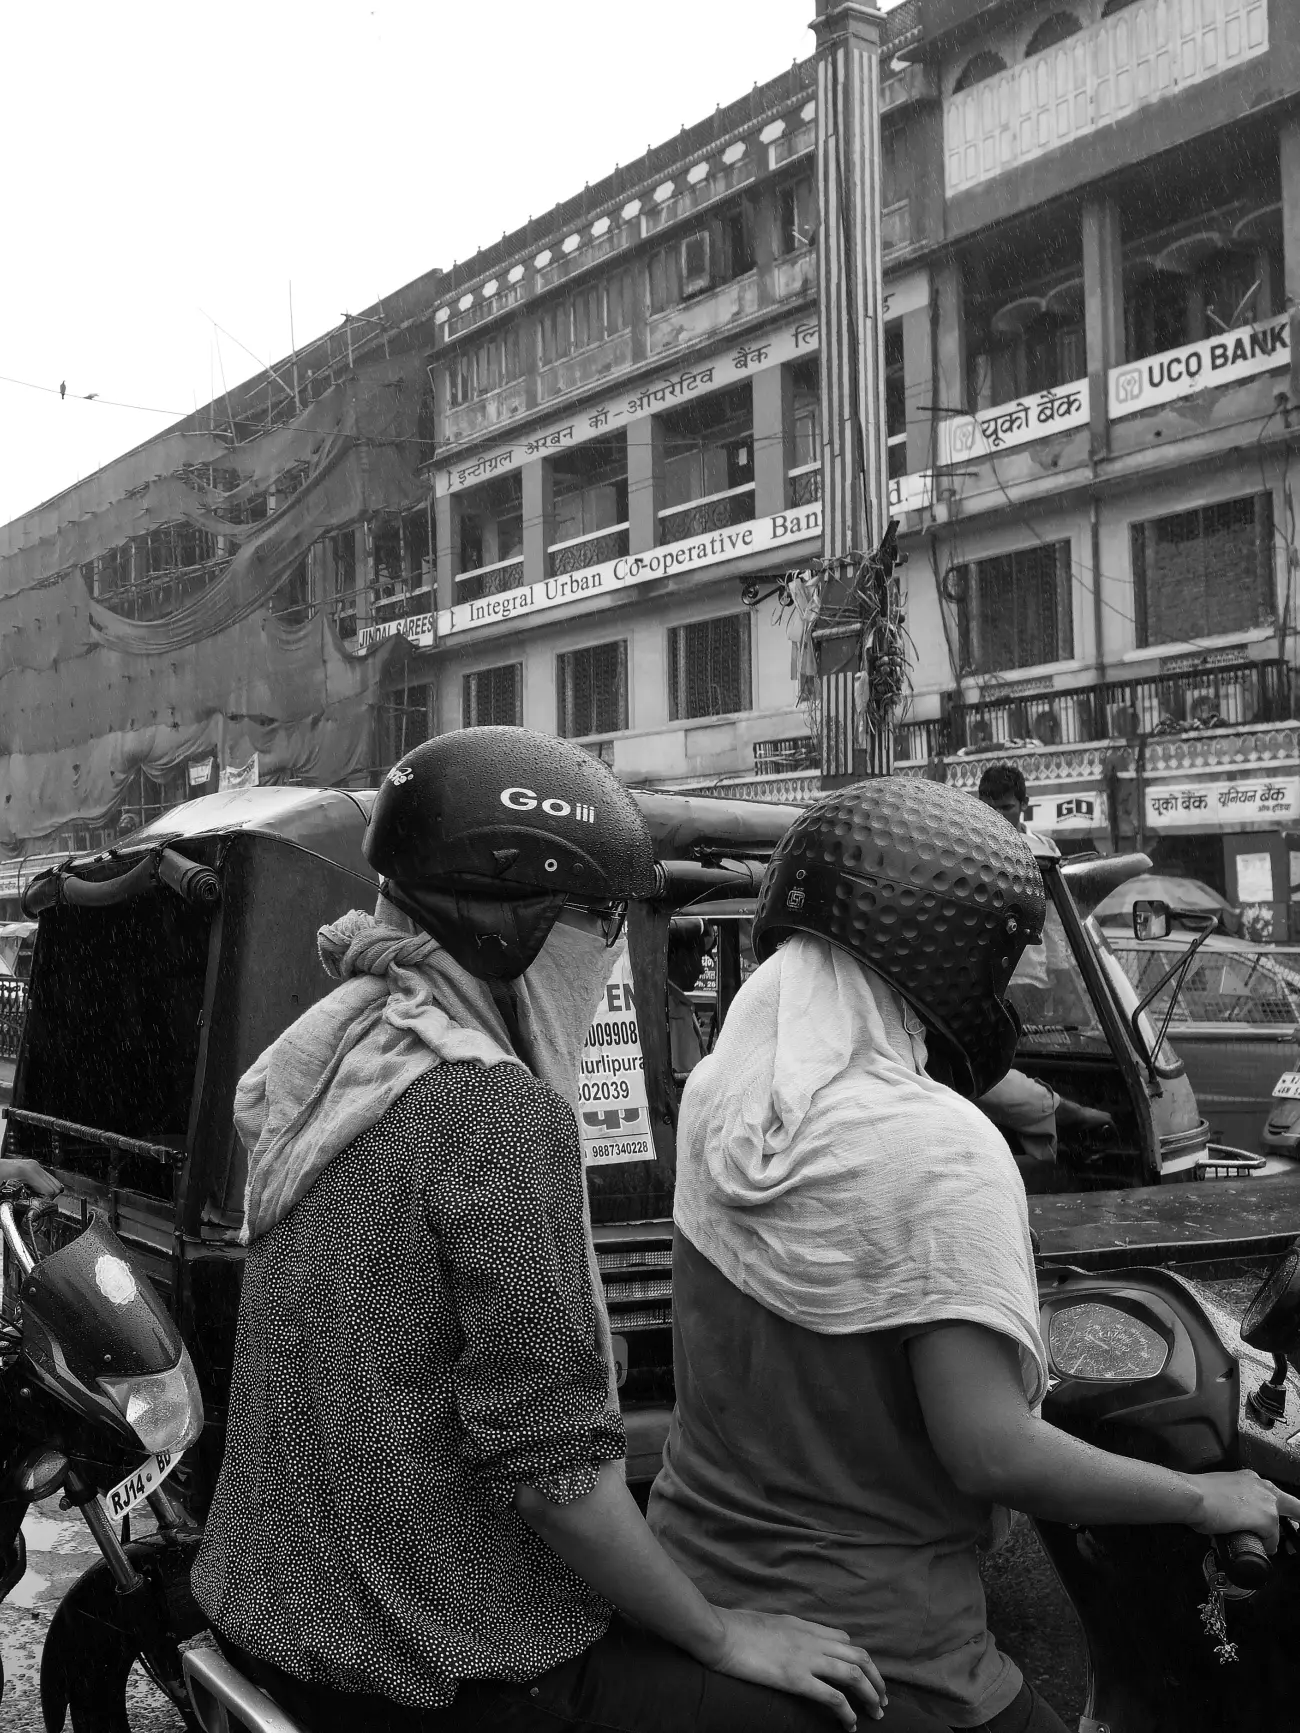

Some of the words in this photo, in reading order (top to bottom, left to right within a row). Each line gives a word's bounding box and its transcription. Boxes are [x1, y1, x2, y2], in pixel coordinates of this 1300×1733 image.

[1147, 352, 1201, 388] UCO
[1210, 323, 1291, 372] BANK
[980, 402, 1032, 448] यूको
[1036, 390, 1083, 424] बैंक
[468, 587, 535, 623] Integral
[543, 572, 603, 600] Urban
[612, 529, 754, 582] Co-operative
[769, 509, 822, 540] Ban
[584, 1020, 638, 1048] 009908
[592, 1140, 649, 1158] 9887340228
[111, 1473, 147, 1516] RJ14
